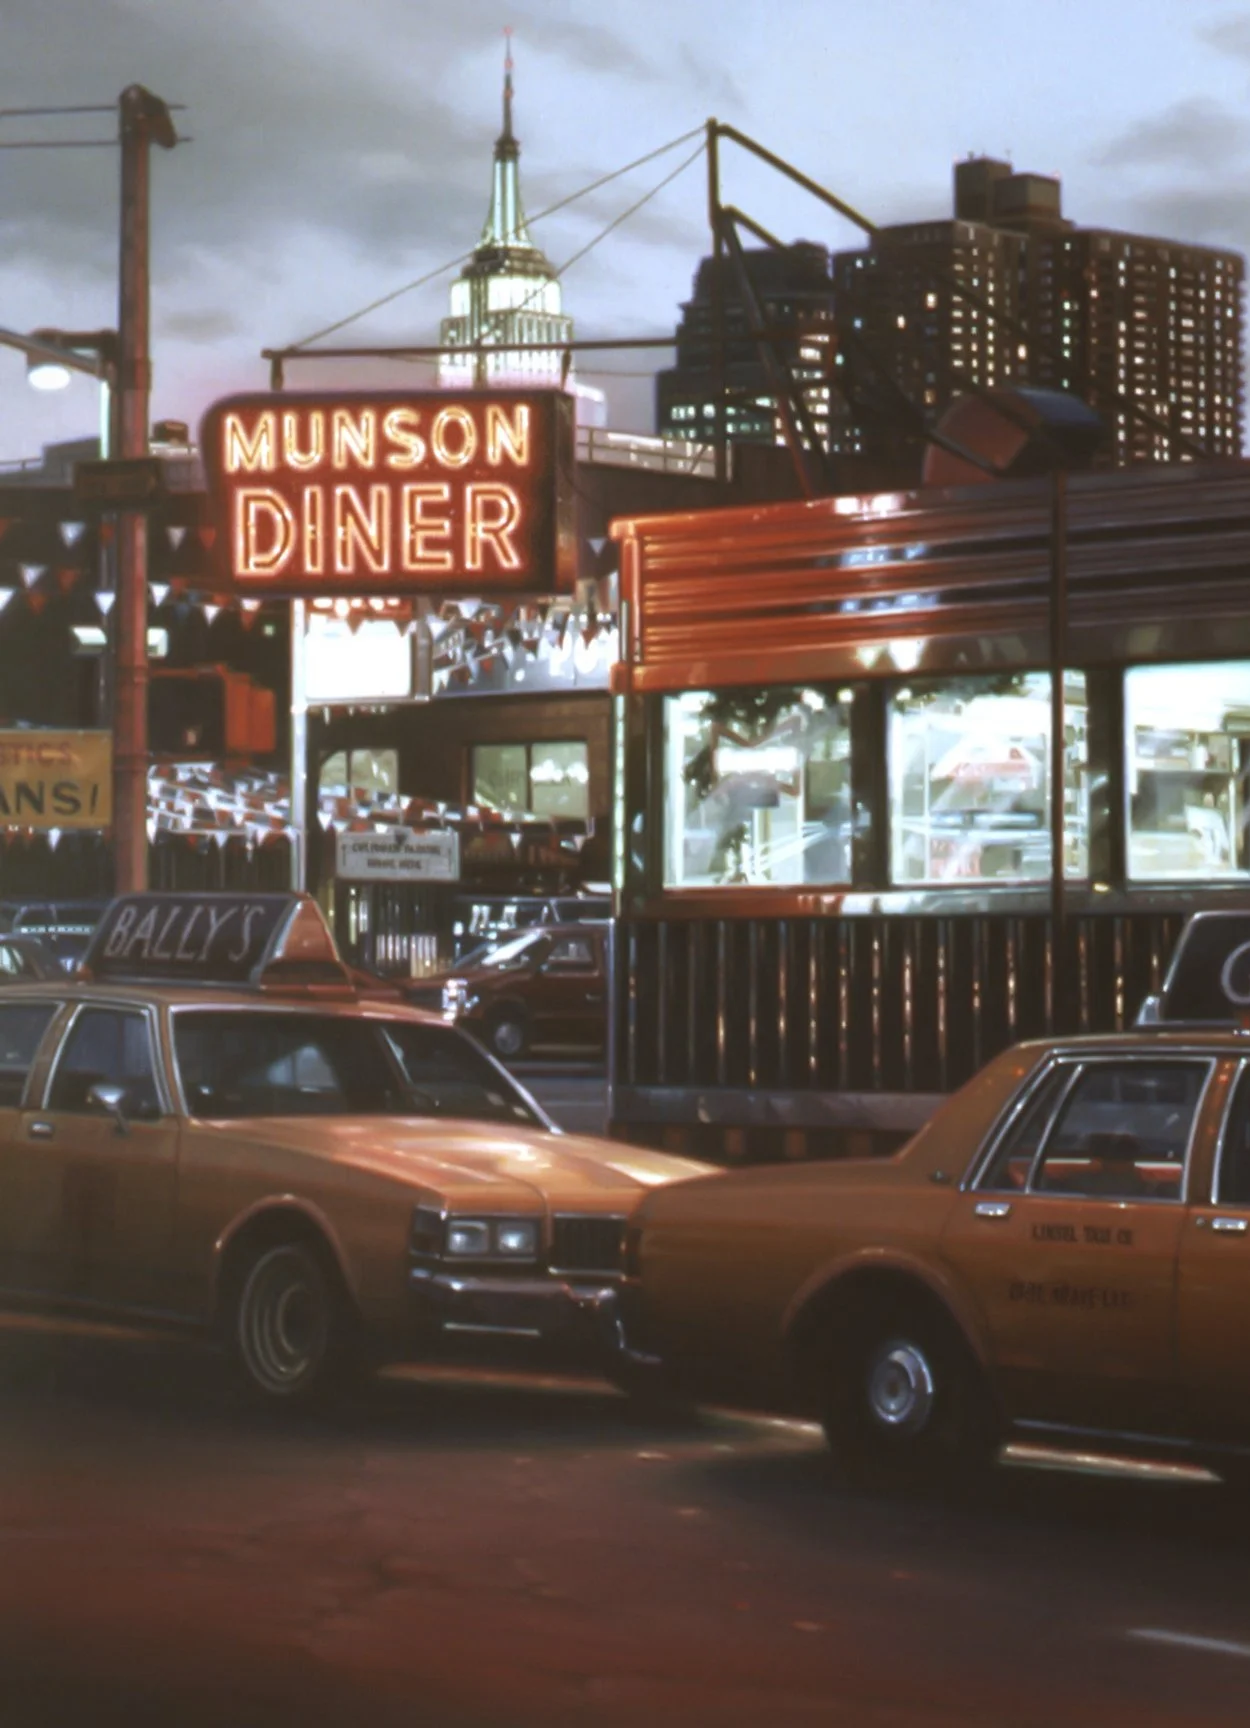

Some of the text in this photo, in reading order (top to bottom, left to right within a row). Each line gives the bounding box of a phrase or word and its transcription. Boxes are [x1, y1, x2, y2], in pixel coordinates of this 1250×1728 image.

[223, 404, 531, 473] MUNSON
[234, 482, 522, 577] DINER
[103, 903, 265, 963] BALLY'S
